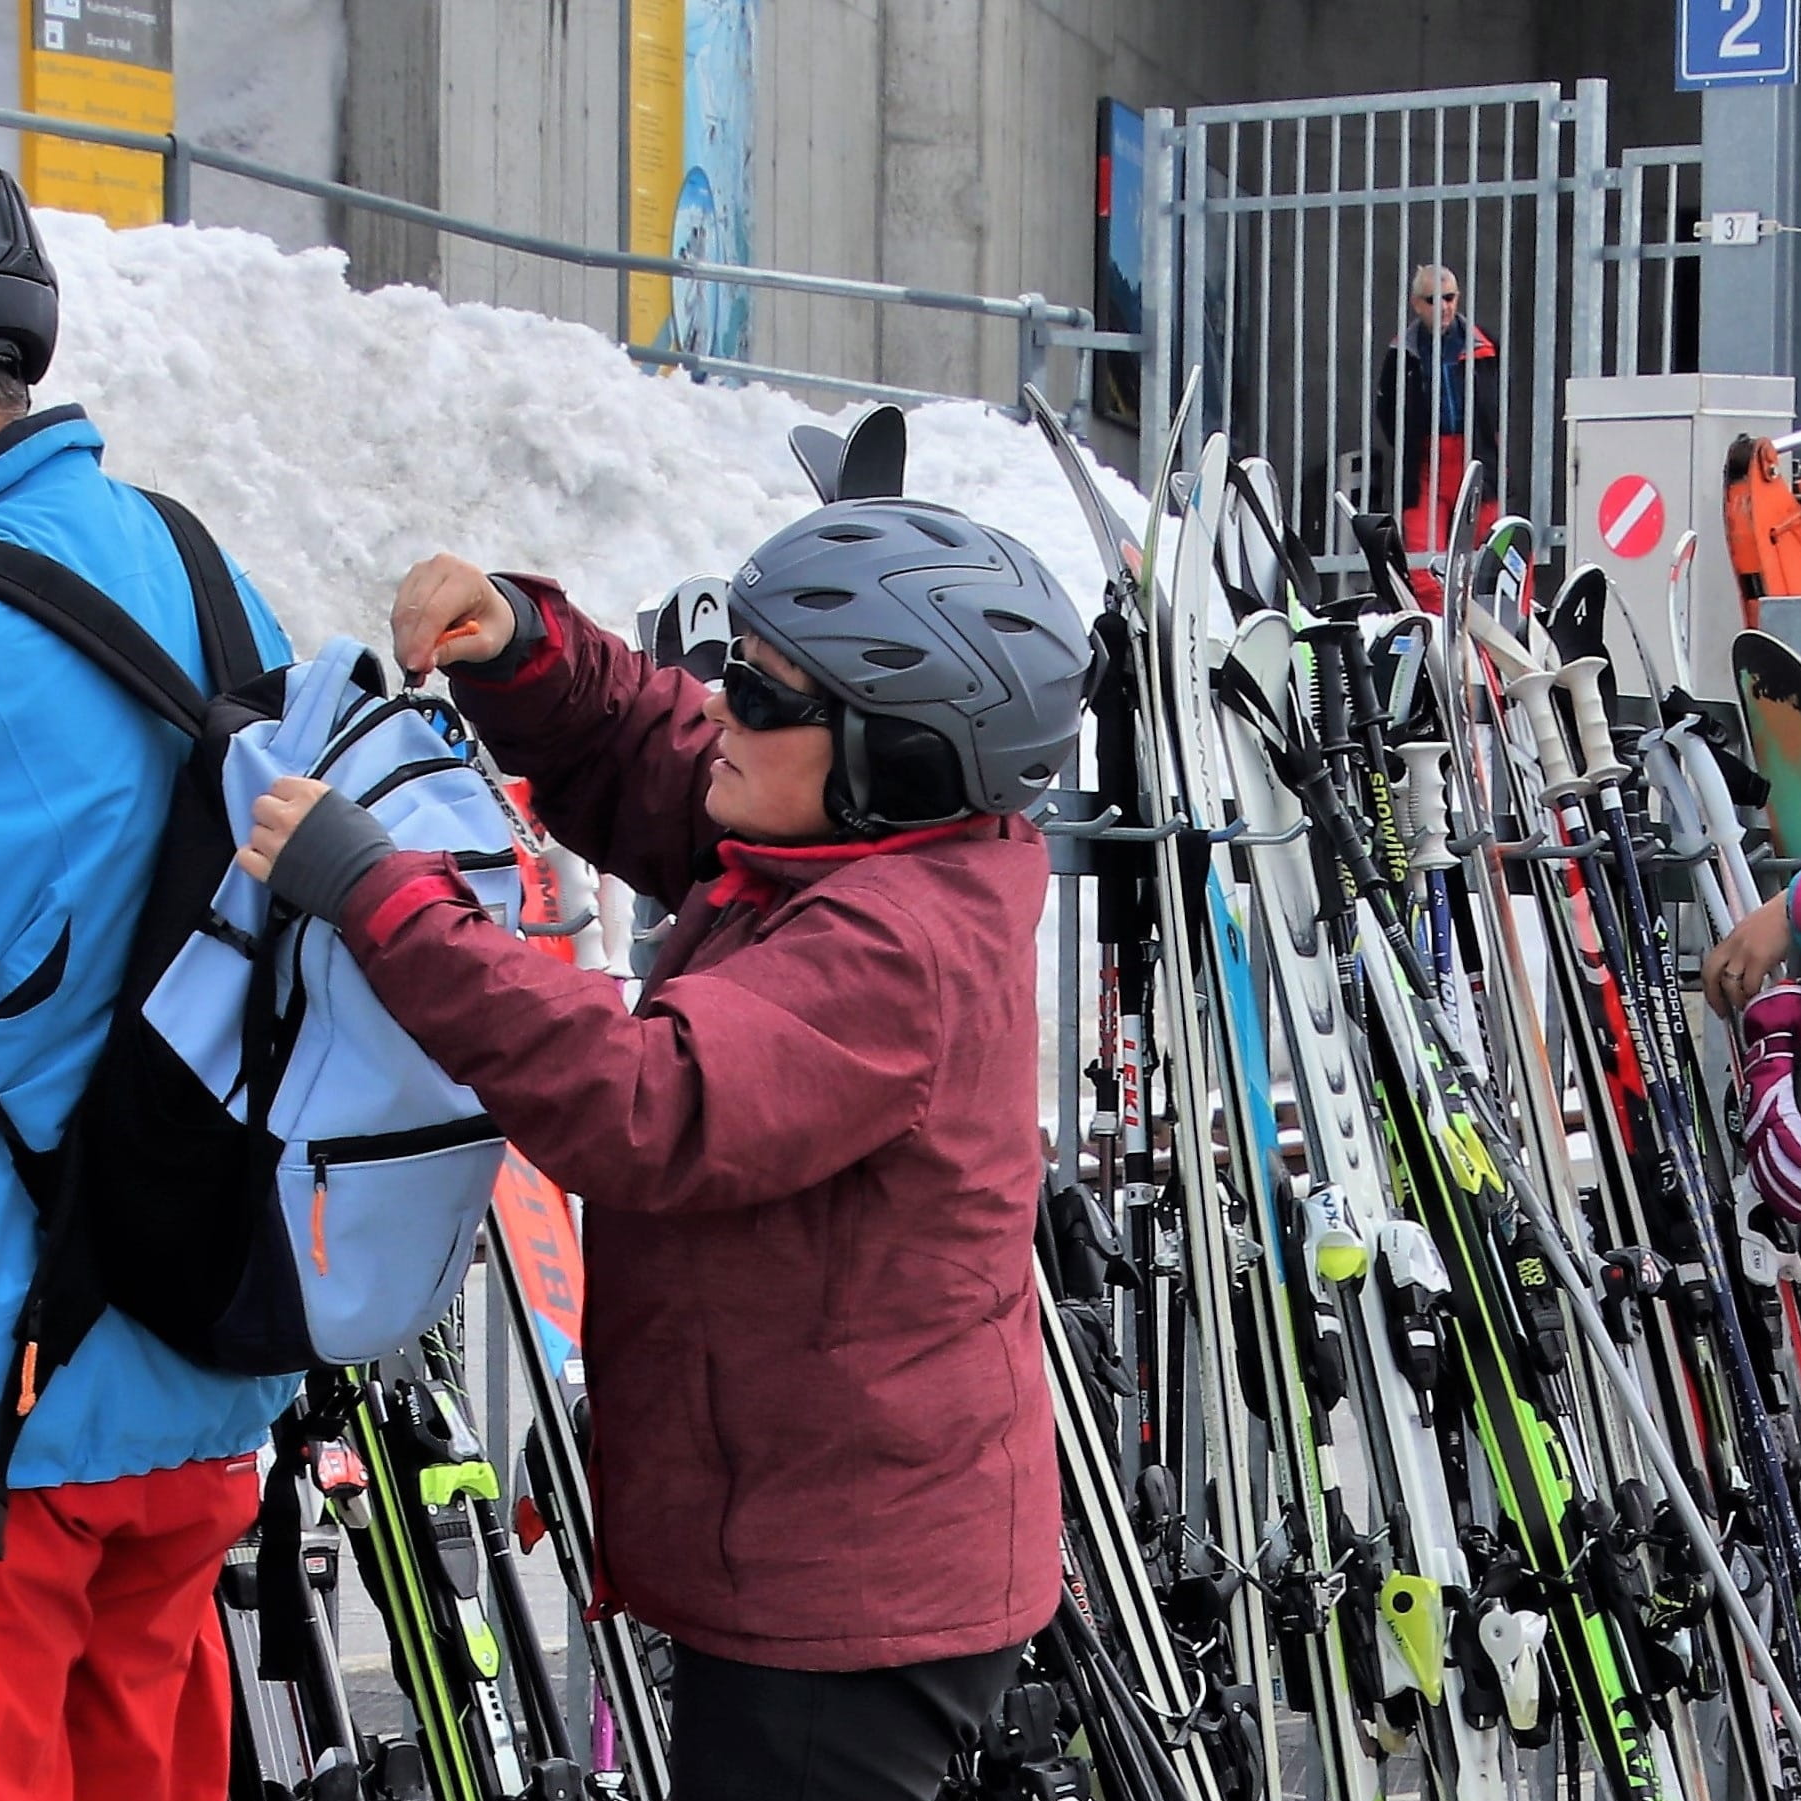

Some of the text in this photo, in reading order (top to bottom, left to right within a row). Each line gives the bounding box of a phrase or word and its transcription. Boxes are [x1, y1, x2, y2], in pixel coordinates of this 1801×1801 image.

[1719, 0, 1761, 58] 2
[1724, 217, 1746, 240] 37
[1368, 771, 1409, 883] snowlife
[1122, 1038, 1140, 1128] LEKI
